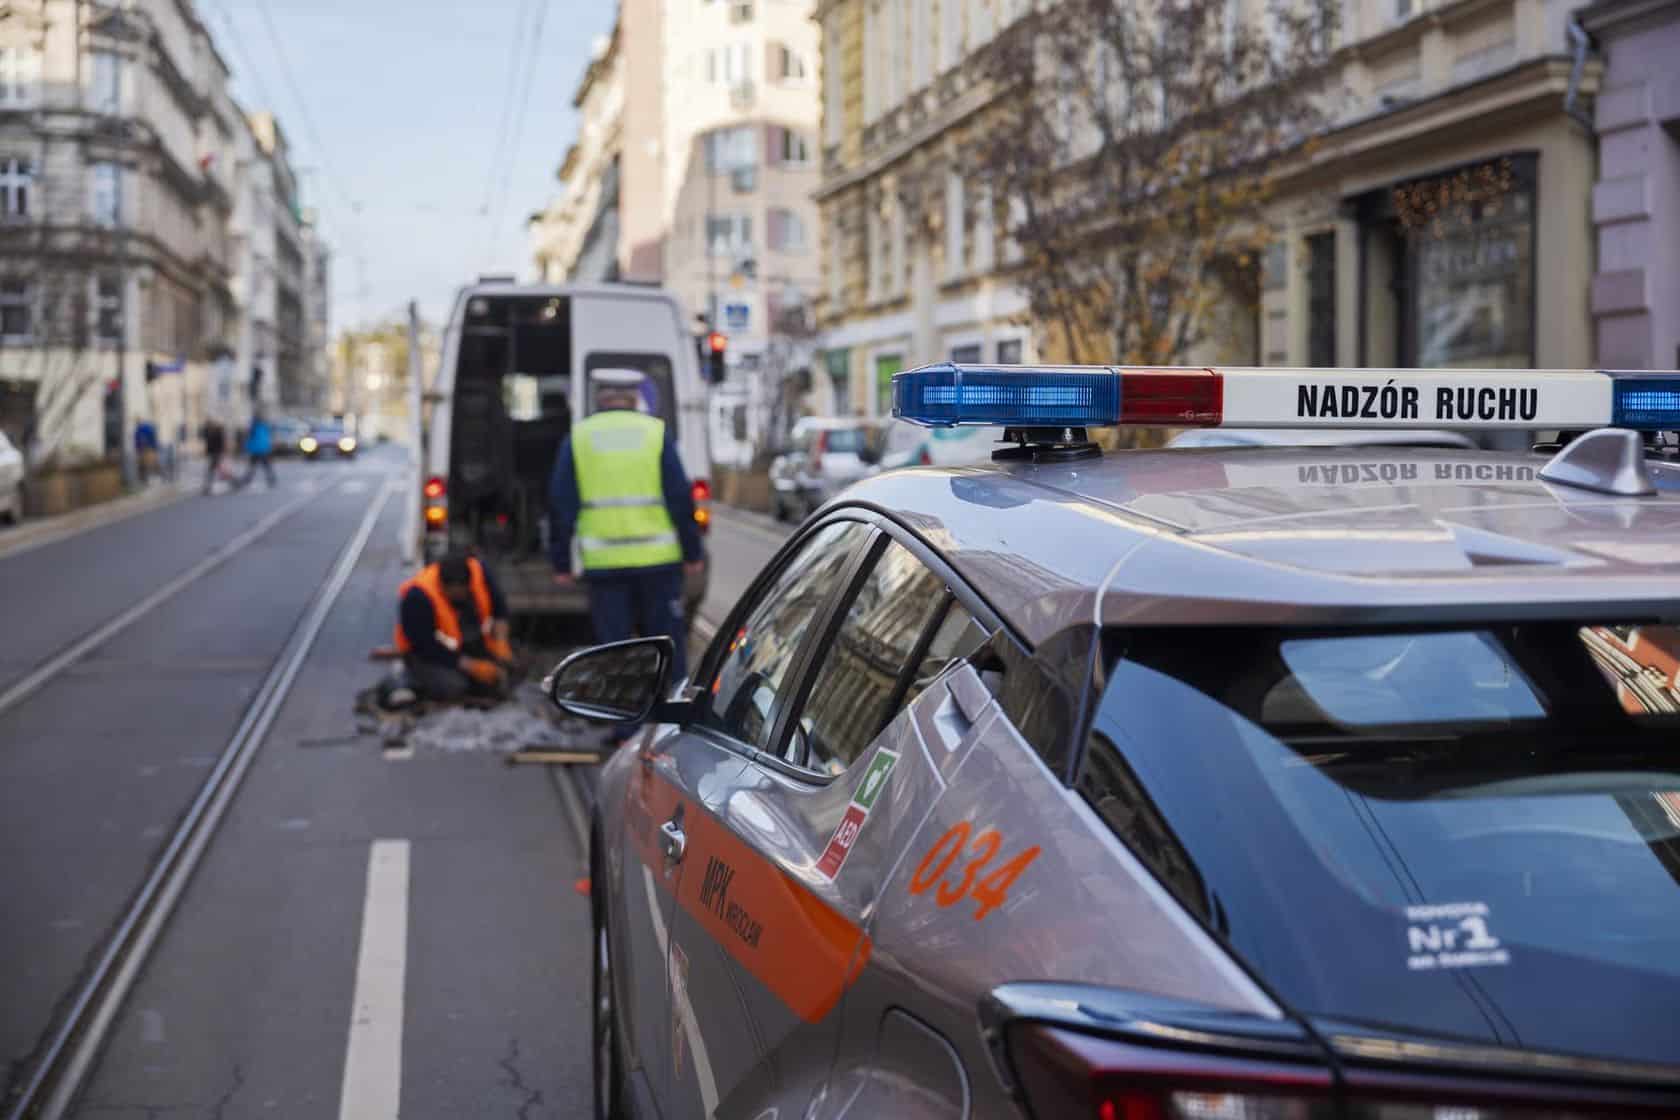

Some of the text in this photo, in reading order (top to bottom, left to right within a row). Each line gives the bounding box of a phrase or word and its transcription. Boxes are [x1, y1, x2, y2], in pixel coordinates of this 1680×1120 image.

[1297, 378, 1538, 420] NADZÓR RUCHU
[700, 856, 735, 920] MPK
[909, 821, 1041, 921] 034
